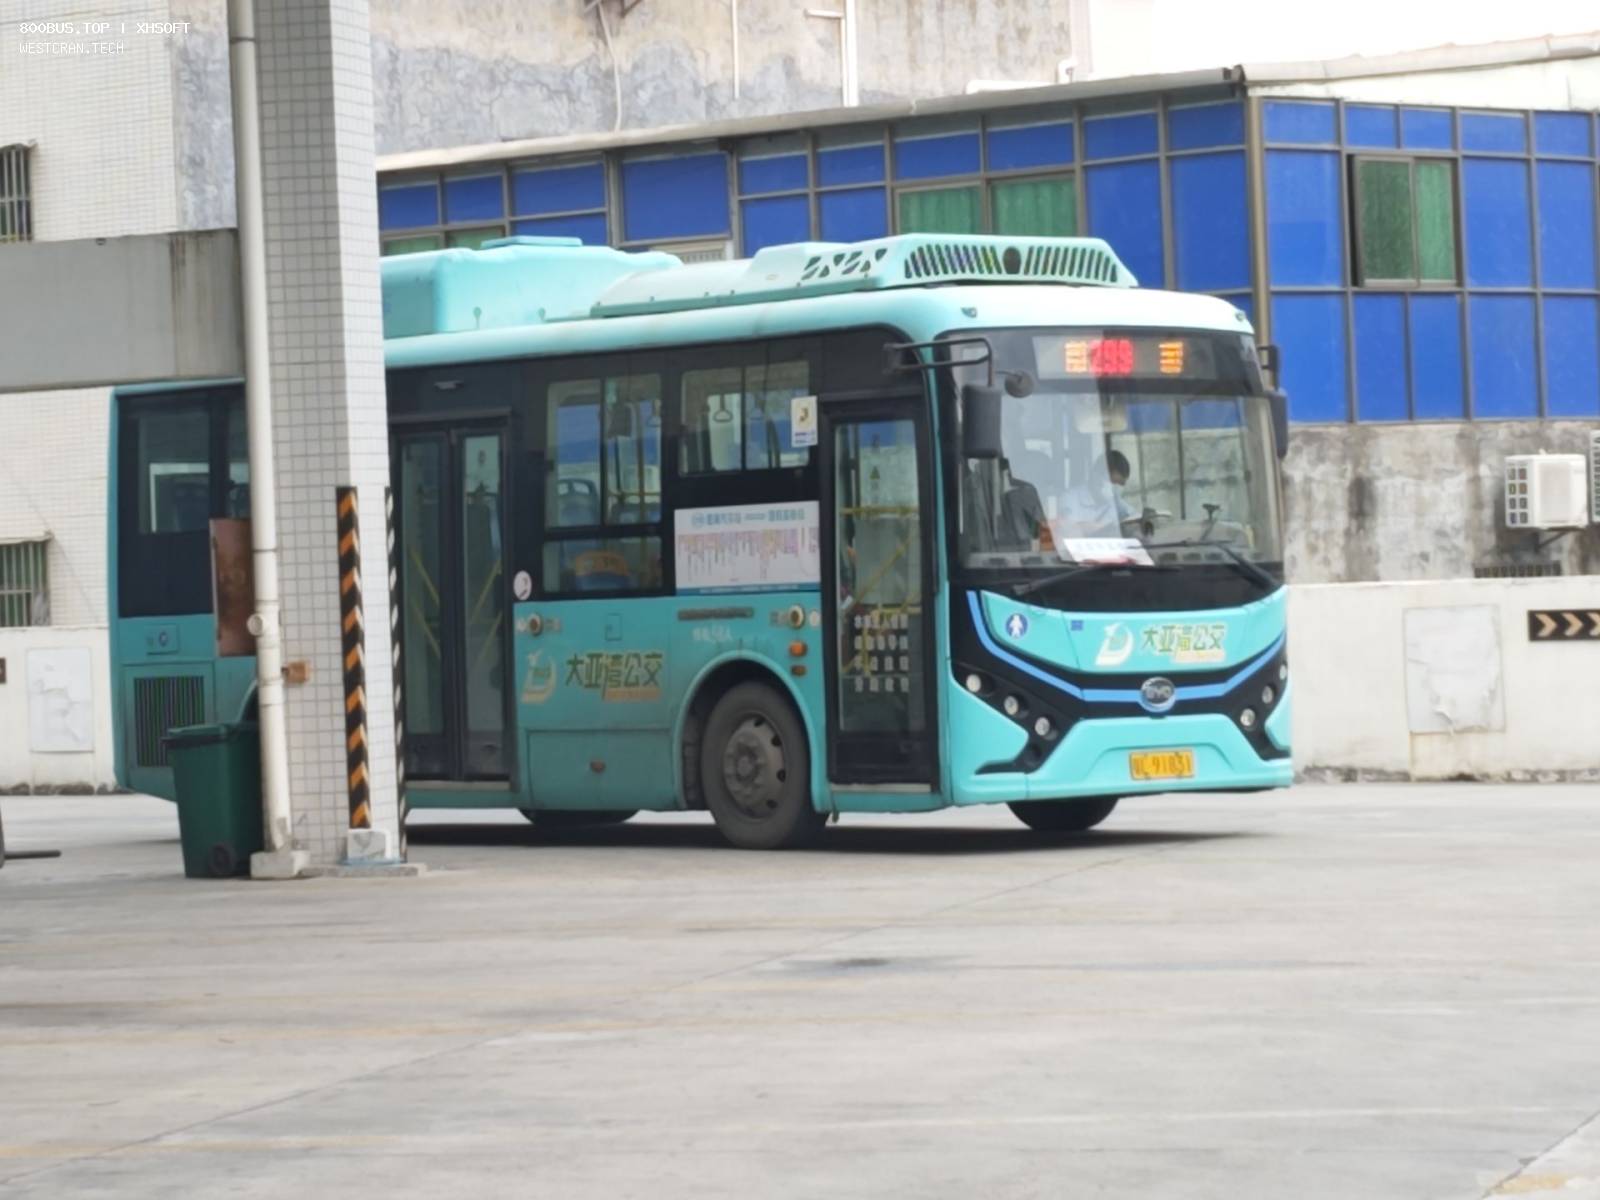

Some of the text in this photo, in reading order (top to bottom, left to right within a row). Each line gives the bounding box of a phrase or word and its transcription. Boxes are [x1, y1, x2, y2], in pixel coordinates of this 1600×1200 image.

[565, 651, 664, 696] 大亚湾公交
